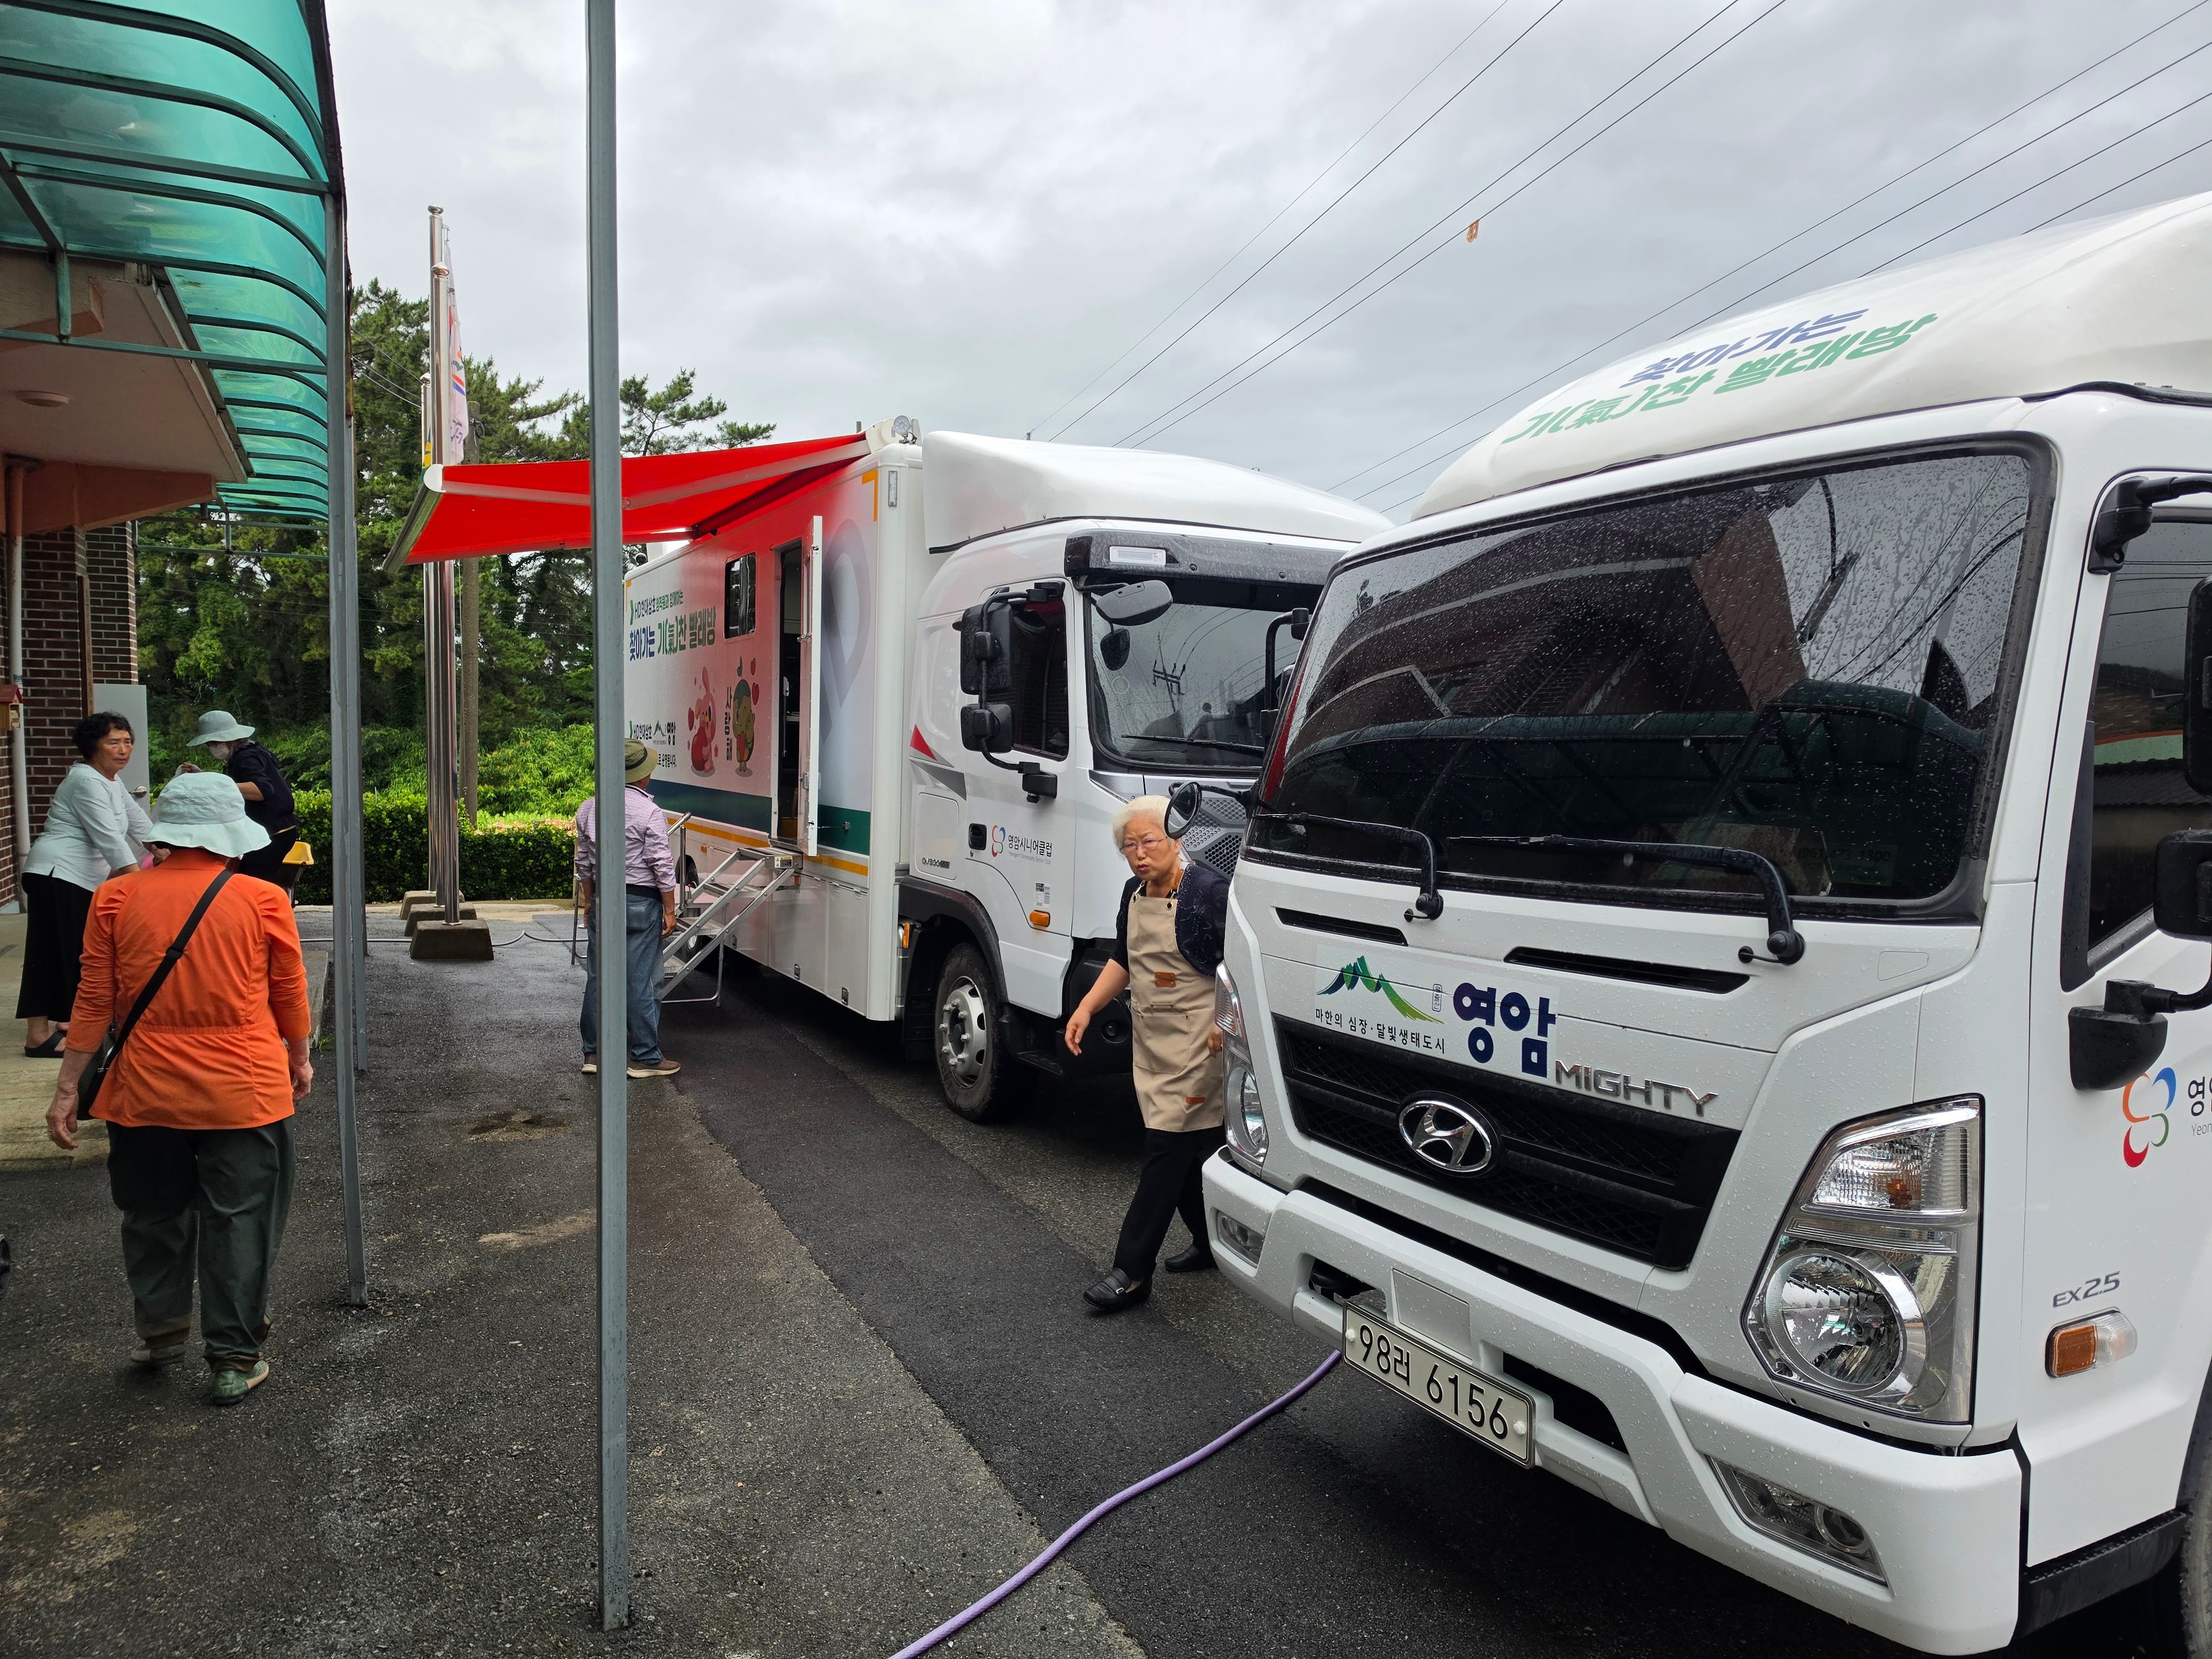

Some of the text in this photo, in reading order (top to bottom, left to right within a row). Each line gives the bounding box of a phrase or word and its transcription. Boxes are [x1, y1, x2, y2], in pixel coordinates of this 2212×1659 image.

[1620, 309, 1869, 389] 찾아가는
[1714, 313, 1938, 394] 빨래방
[629, 606, 717, 661] 찾아가는 기(氣)찬 빨래방
[666, 721, 676, 745] 영암
[724, 686, 733, 761] 사랑해
[1008, 834, 1052, 857] 영암시니어클럽
[1316, 1008, 1342, 1028] 마한의
[1453, 982, 1556, 1078] 영암
[1555, 1059, 1719, 1117] MIGHTY
[2188, 1076, 2212, 1117] 영
[1359, 1324, 1509, 1440] 98러 6156
